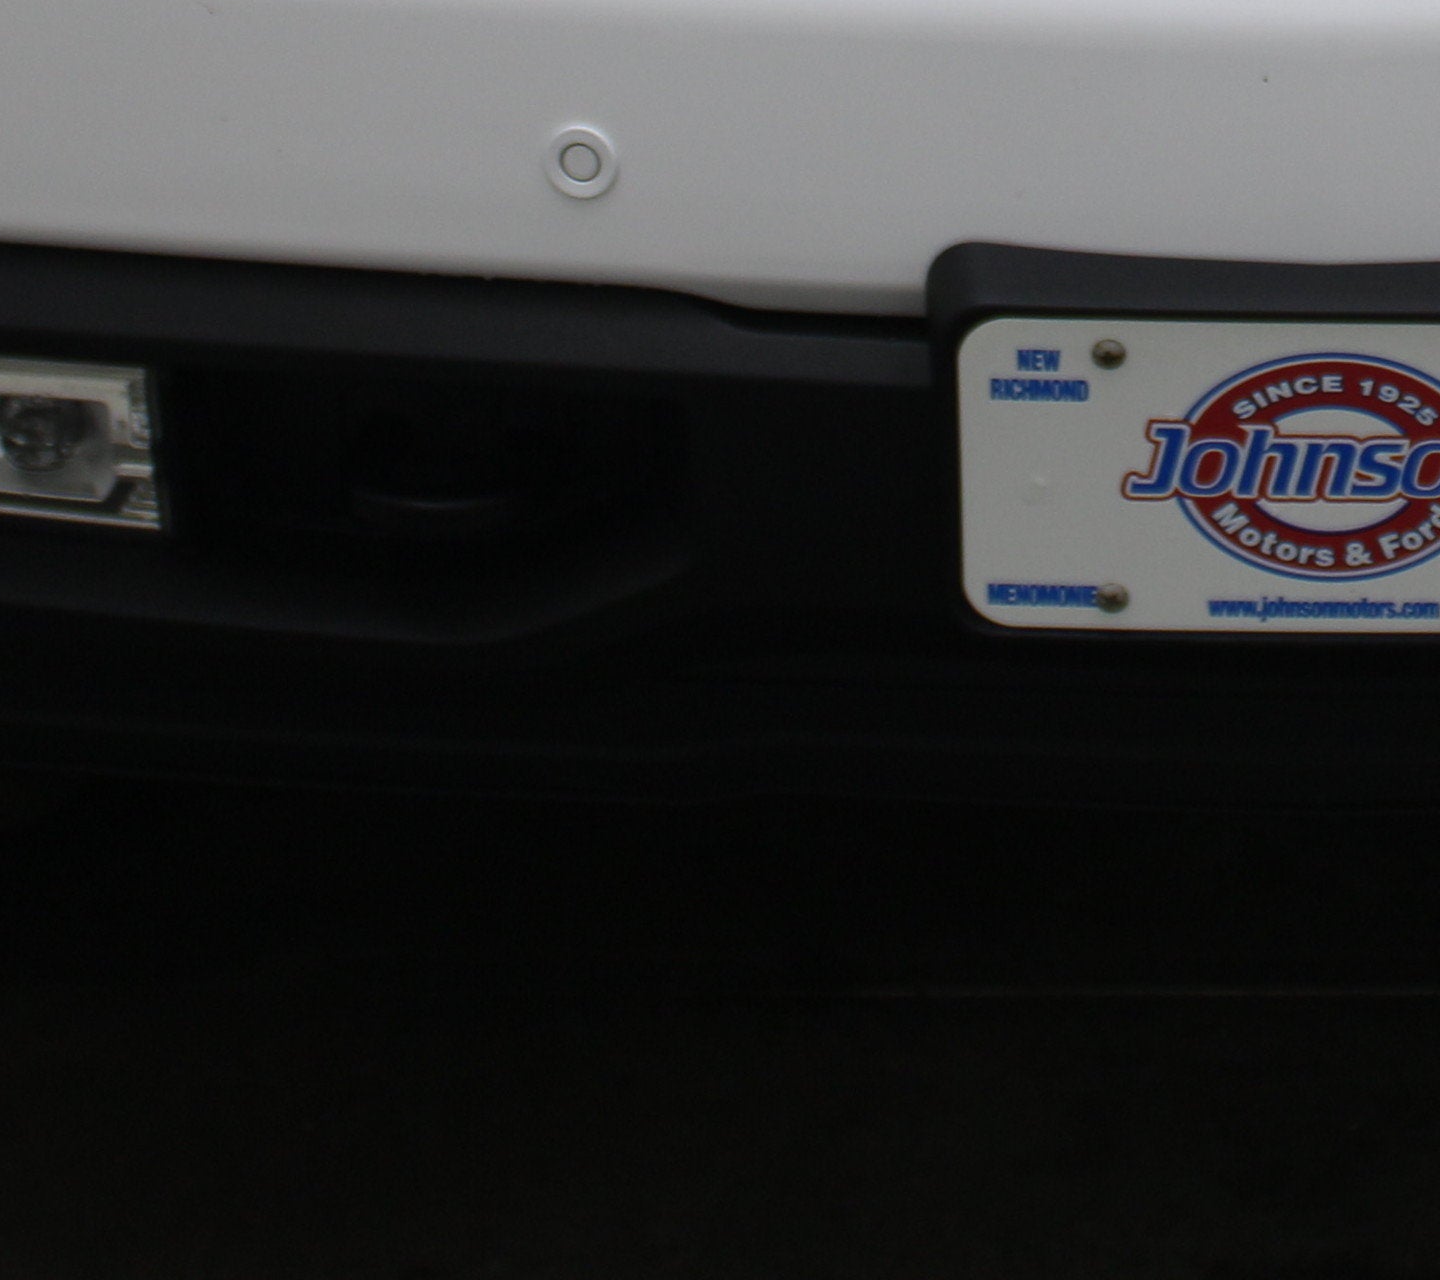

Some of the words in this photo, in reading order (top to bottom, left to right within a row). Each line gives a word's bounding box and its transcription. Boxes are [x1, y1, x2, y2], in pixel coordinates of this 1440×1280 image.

[1017, 349, 1060, 372] NEW
[989, 378, 1090, 403] RICHMOND
[1232, 374, 1344, 420] SINCE
[1359, 379, 1439, 426] 1925
[1212, 502, 1336, 568] Motors
[1344, 541, 1374, 567] &
[1207, 596, 1440, 622] www.johnsonmotors.com
